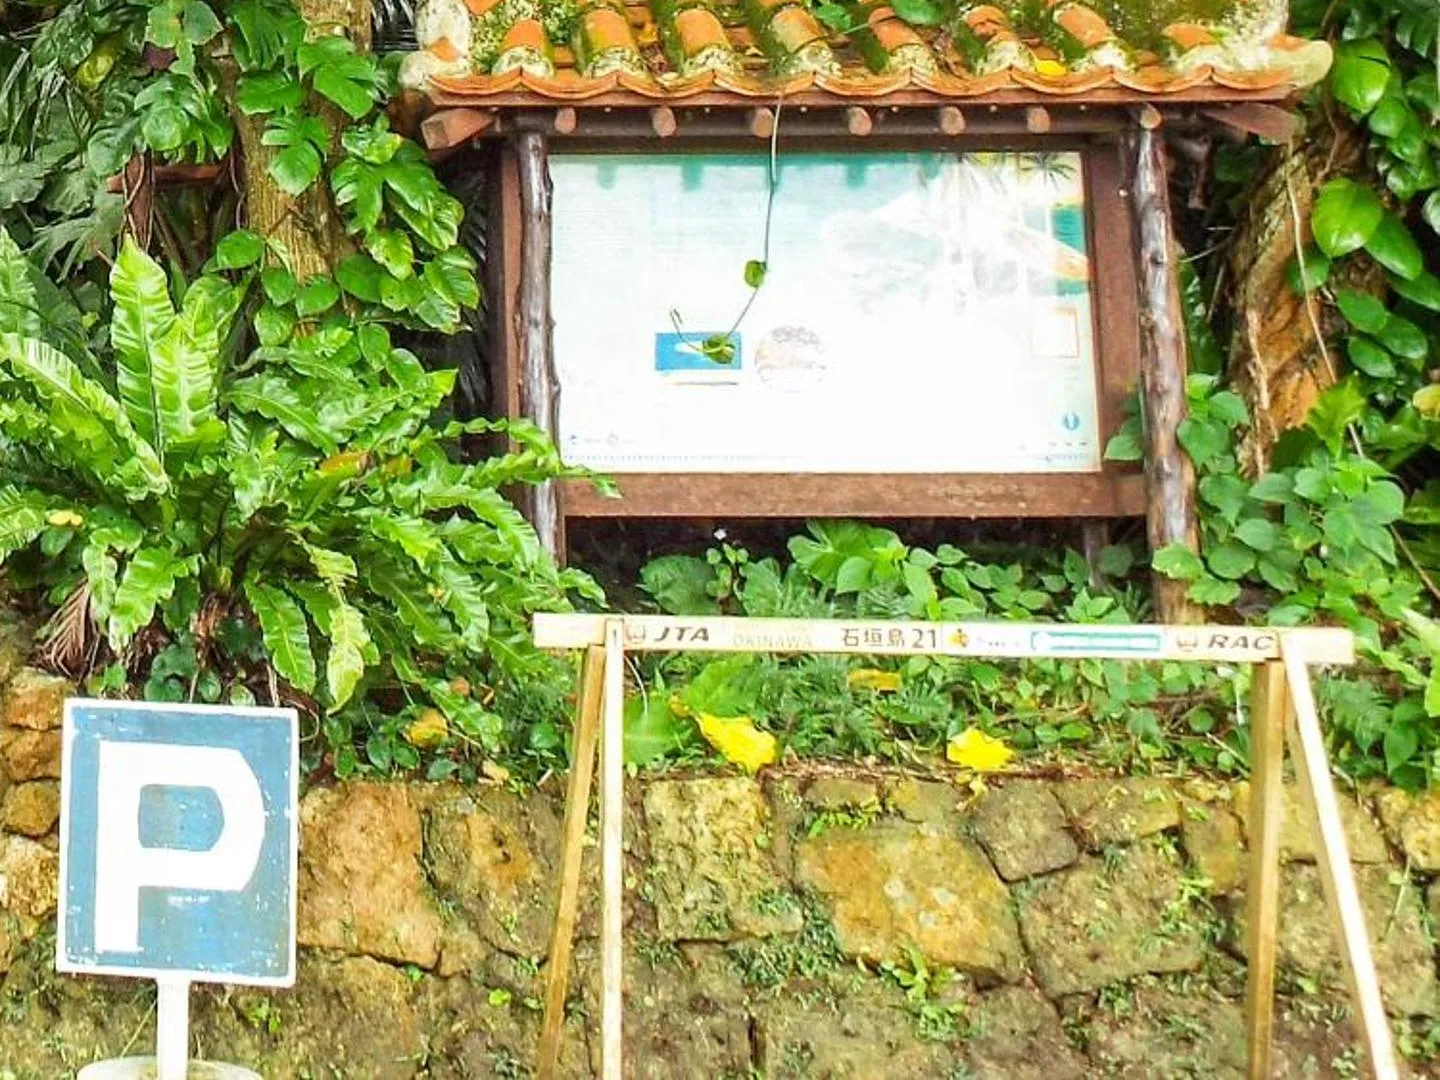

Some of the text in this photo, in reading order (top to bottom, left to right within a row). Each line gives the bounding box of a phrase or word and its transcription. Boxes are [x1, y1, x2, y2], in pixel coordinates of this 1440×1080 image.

[653, 626, 711, 643] JTA
[1207, 634, 1276, 651] RAC
[95, 740, 266, 954] P
